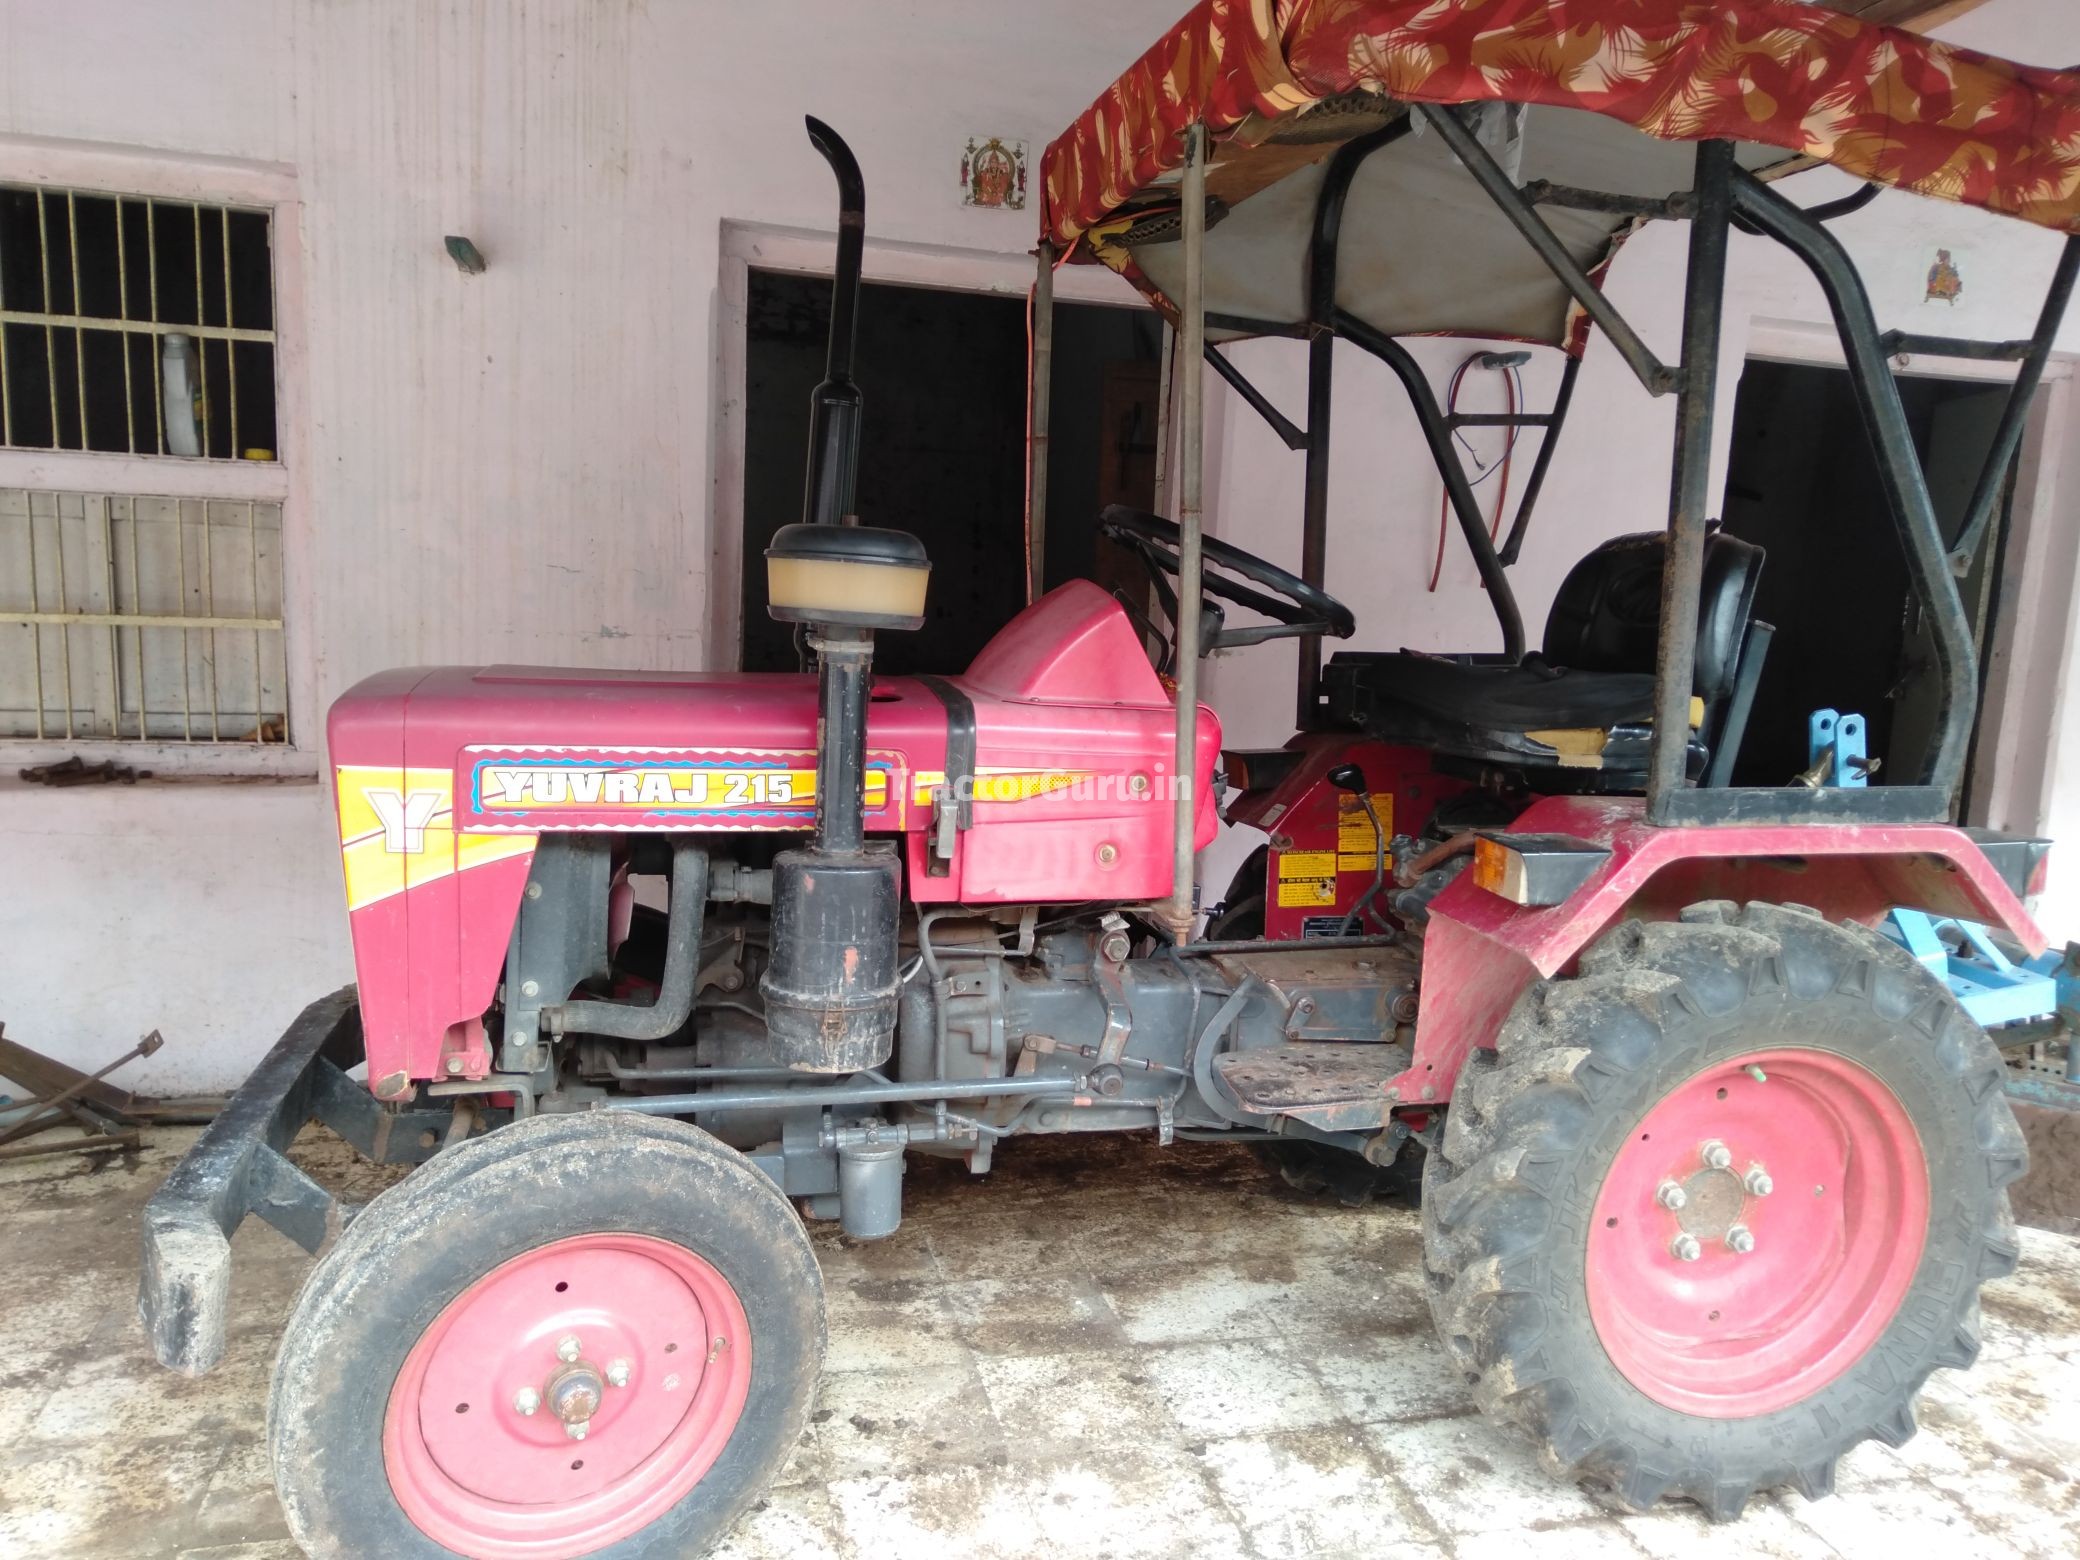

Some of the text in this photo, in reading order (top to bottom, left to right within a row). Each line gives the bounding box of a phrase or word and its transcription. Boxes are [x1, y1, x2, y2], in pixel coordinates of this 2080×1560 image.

[493, 771, 794, 804] YUVRAJ 215
[361, 787, 446, 854] Y
